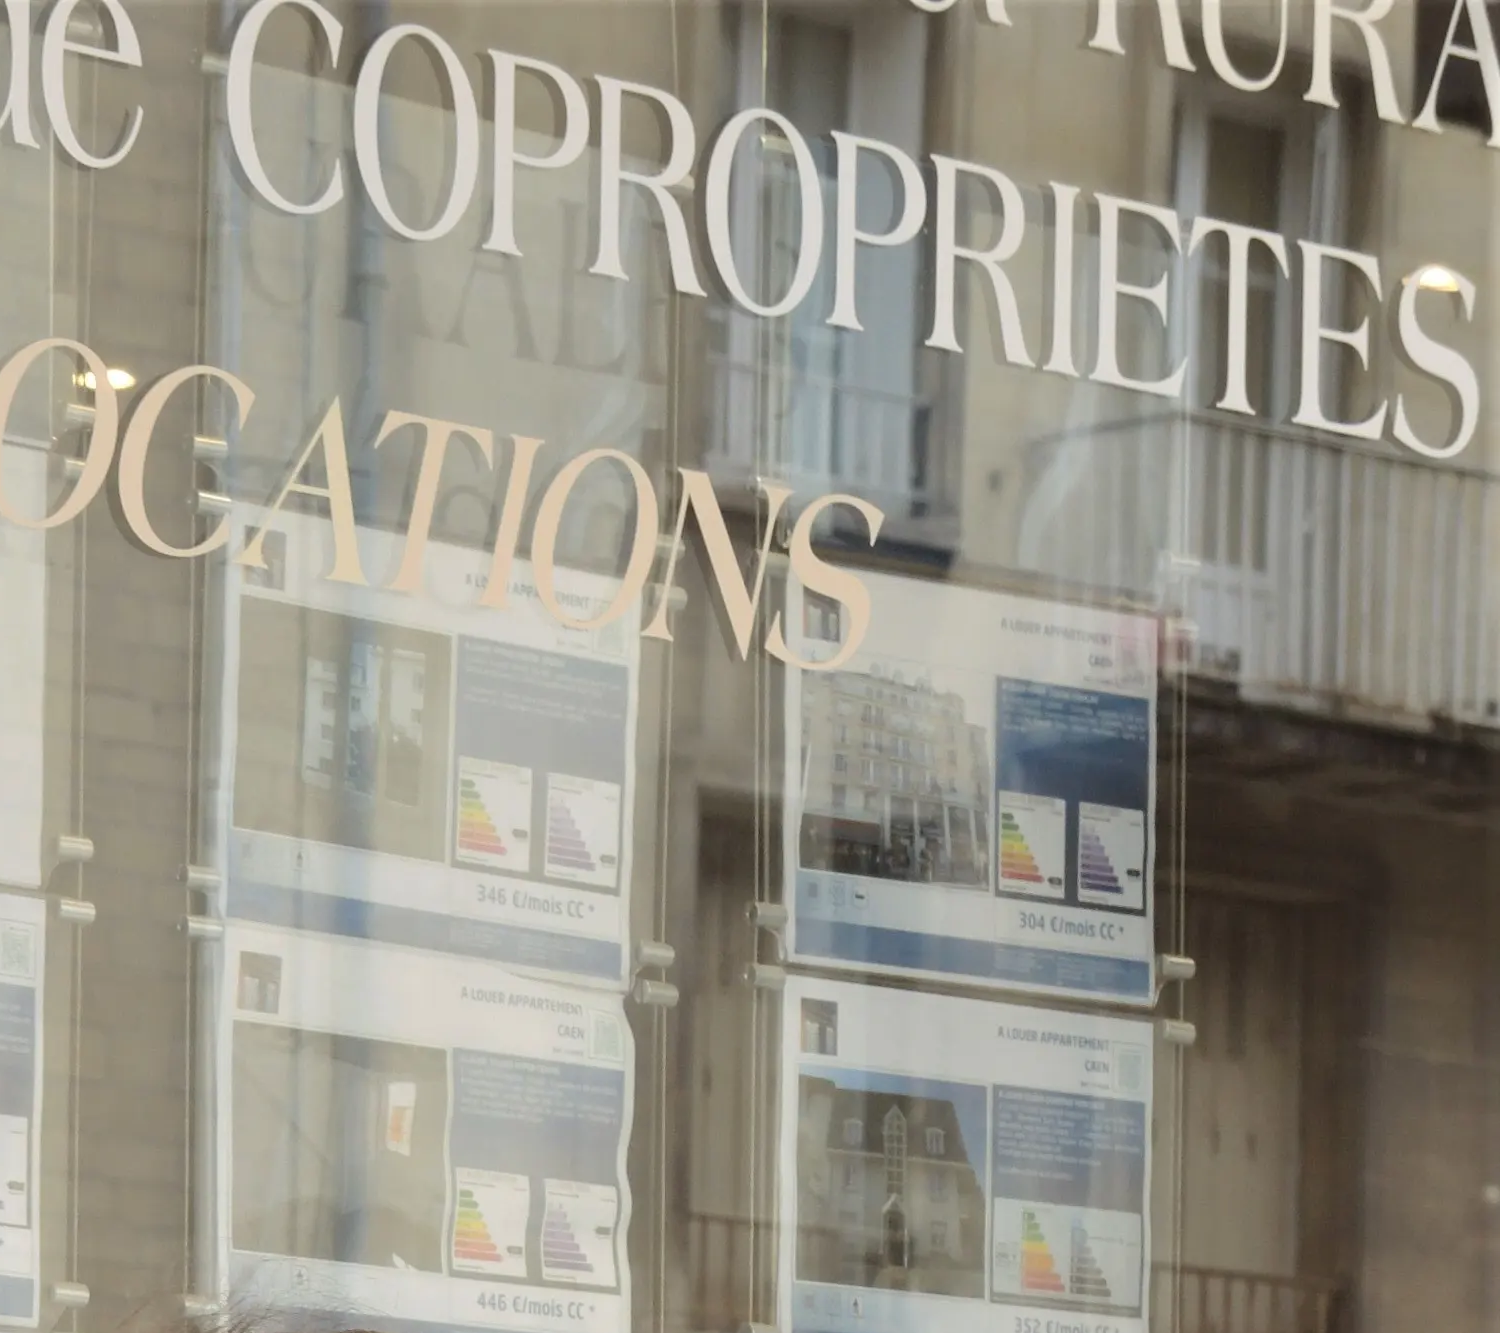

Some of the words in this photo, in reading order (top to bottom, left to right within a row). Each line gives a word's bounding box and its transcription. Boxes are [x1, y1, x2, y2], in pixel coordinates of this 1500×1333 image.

[227, 0, 1480, 459] COPROPRIETES
[477, 1292, 507, 1312] 446
[512, 1294, 564, 1319] €/mois
[568, 1300, 586, 1320] CC
